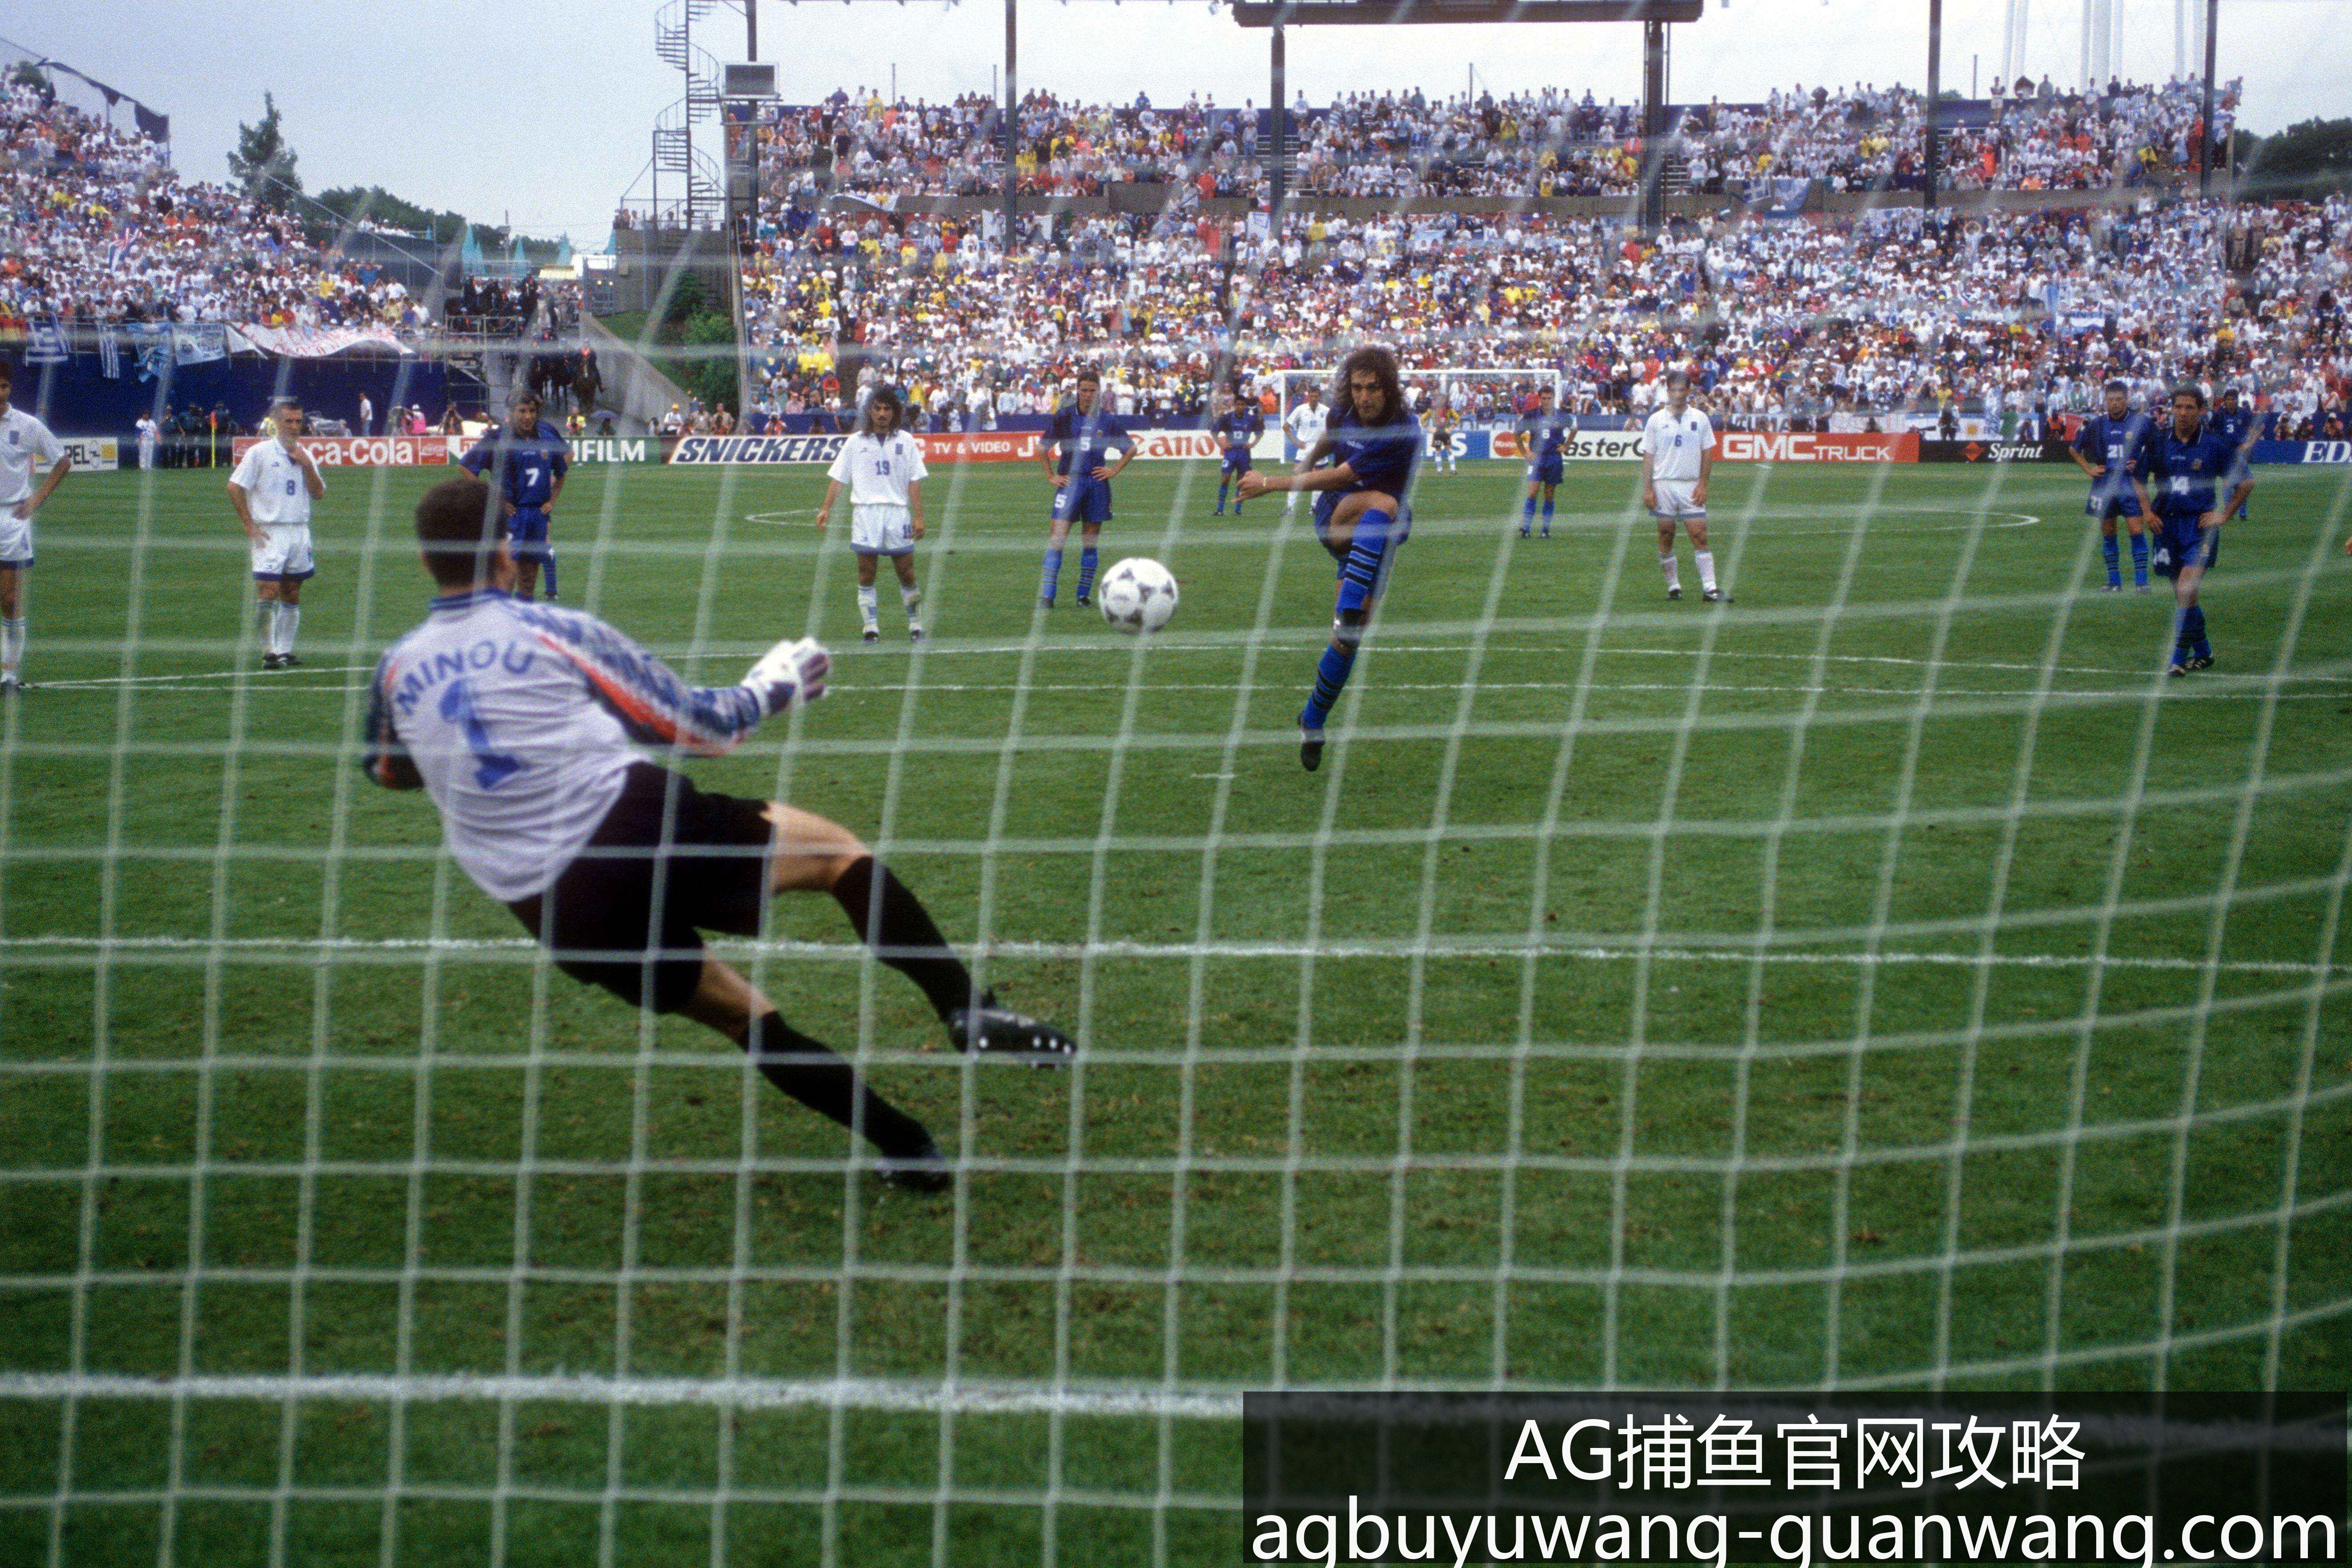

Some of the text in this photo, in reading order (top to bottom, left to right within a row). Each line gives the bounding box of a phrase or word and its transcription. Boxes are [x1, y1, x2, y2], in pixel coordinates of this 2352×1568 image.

[676, 437, 849, 462] SNICKERS
[934, 442, 951, 454] TV
[971, 441, 1011, 454] VIDEO
[1080, 437, 1091, 452] 5
[1564, 437, 1645, 457] asterC
[1674, 433, 1682, 447] 6
[1722, 434, 1893, 461] GMC TRUCK
[64, 444, 90, 464] PEL
[311, 439, 413, 465] ca-Cola
[572, 440, 646, 462] IFILM
[1988, 443, 2044, 462] Sprint
[2107, 444, 2124, 458] 21
[2301, 441, 2352, 463] ED
[525, 467, 539, 486] 7
[875, 460, 890, 476] 19
[286, 479, 296, 496] 8
[393, 640, 535, 715] MINOU
[437, 679, 525, 790] 1
